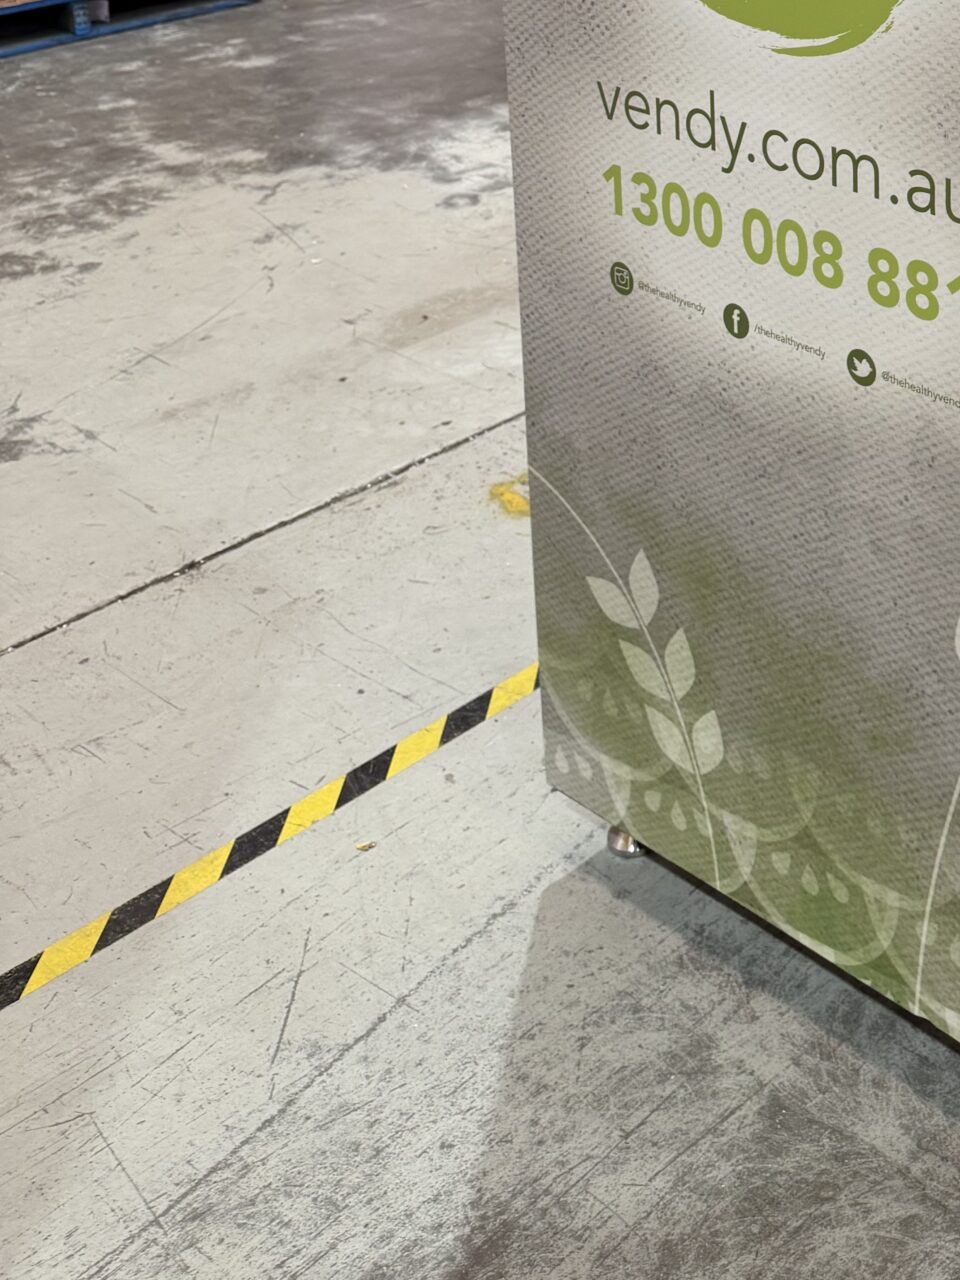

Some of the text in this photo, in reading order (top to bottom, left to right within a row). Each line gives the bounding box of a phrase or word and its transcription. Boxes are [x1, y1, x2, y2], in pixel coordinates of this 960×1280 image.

[602, 164, 723, 248] 1300
[742, 208, 844, 289] 008
[638, 280, 706, 316] @thehealthyvendy
[754, 323, 827, 361] /thehealthyvendy
